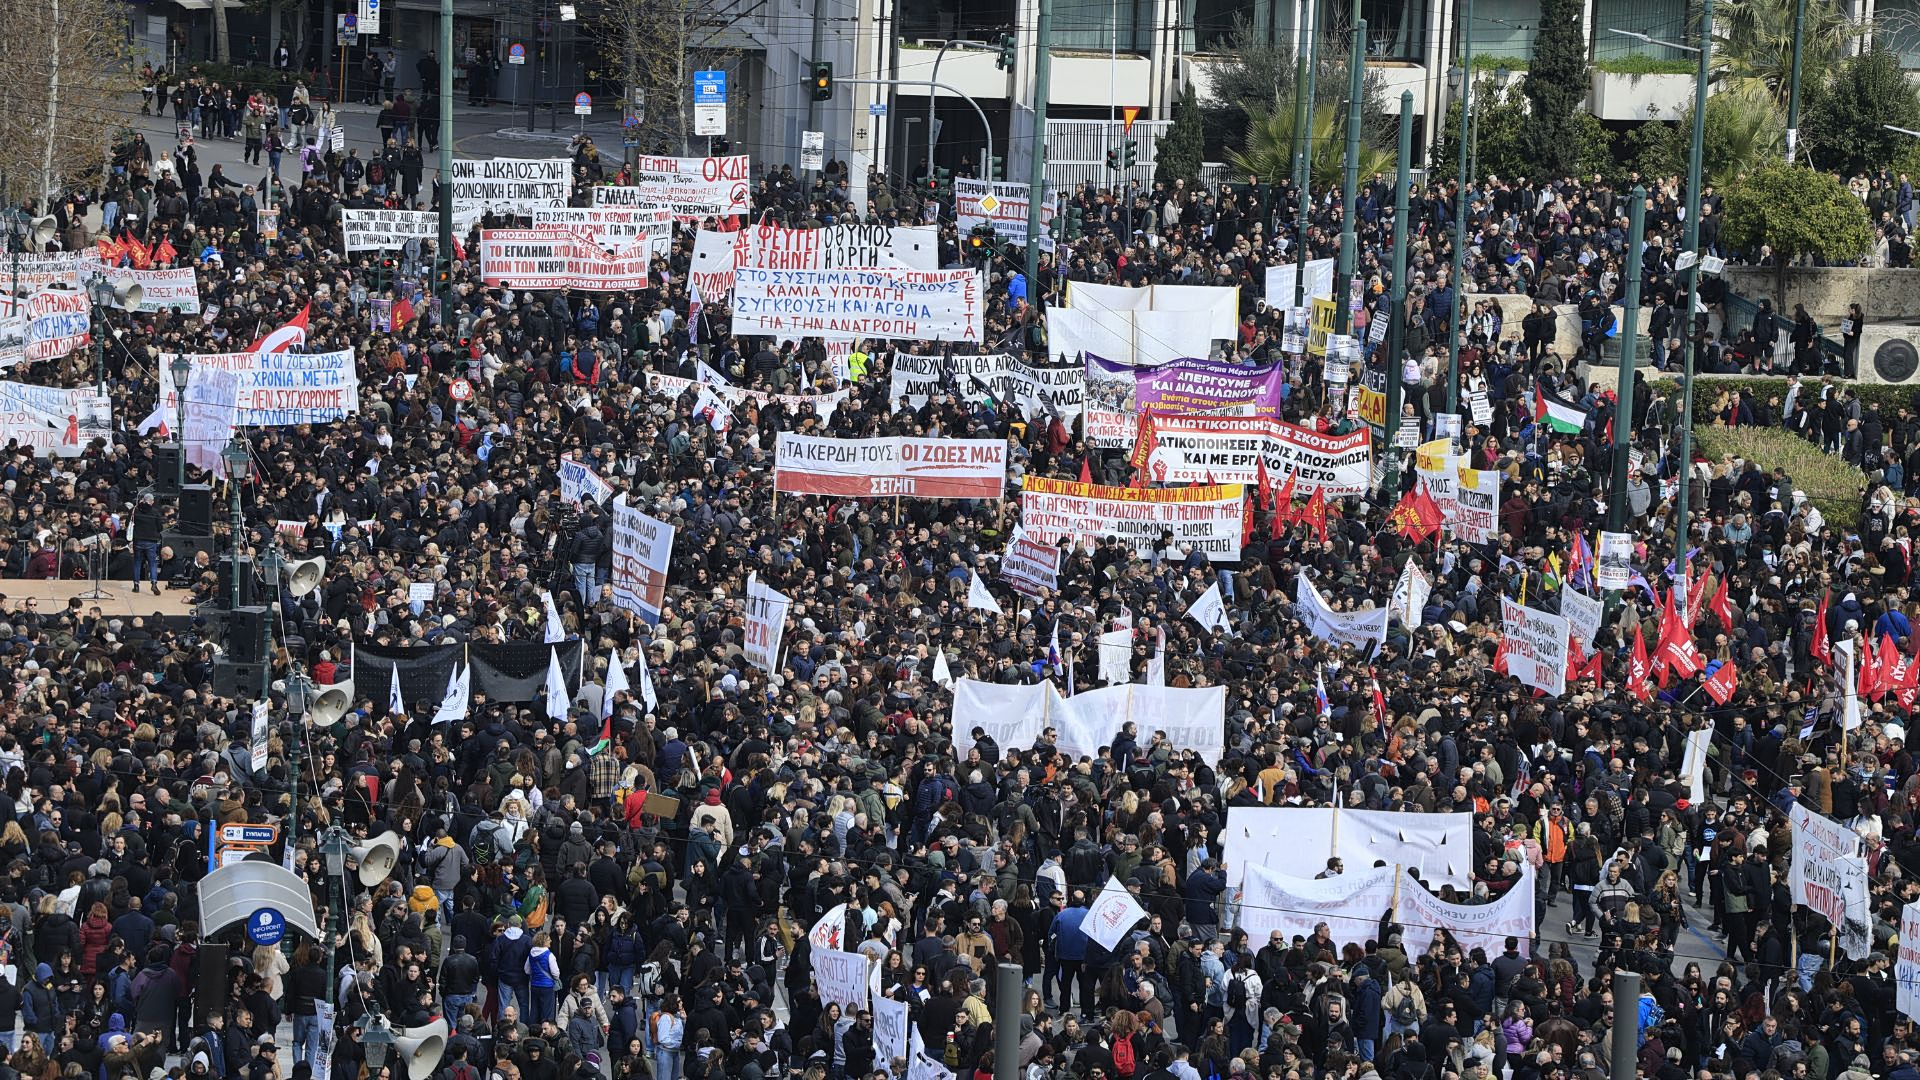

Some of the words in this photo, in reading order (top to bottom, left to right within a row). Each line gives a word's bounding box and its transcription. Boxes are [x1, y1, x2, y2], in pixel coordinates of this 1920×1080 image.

[452, 162, 474, 178] ΟΝΗ
[484, 162, 563, 179] ΔΙΚΑΙΟΣΥΝΗ
[702, 156, 748, 182] ΟΚΔΕ
[452, 182, 504, 200] ΚΟΙΝΩΝΙΚΗ
[508, 181, 564, 199] ΕΠΑΝΑΣΤΑΣΗ
[993, 186, 1004, 196] ΤΑ
[536, 212, 550, 222] ΣΤΟ
[552, 210, 584, 222] ΣΥΣΤΗΜΑ
[588, 211, 601, 222] ΤΟΥ
[604, 211, 632, 222] ΚΕΡΔΟΥΣ
[671, 204, 720, 214] ΚΥΒΕΡΝΗΣΗ
[492, 232, 556, 240] ΟΜΟΣΠΟΝΔΙΑ
[609, 225, 621, 236] ΓΙΑ
[624, 225, 637, 236] ΤΗΝ
[758, 227, 819, 251] ΦΕΥΓΕΙ
[836, 226, 893, 248] ΘΥΜΟΣ
[490, 246, 502, 258] ΤΟ
[505, 246, 552, 258] ΕΓΚΛΗΜΑ
[554, 246, 570, 258] ΑΥΤΟ
[758, 250, 819, 270] ΣΒΗΝΕΙ
[826, 250, 832, 268] Η
[838, 246, 878, 268] ΟΡΓΗ
[134, 268, 193, 280] ΣΥΓΧΩΡΟΥΜΕ
[485, 260, 512, 272] ΟΛΩΝ
[514, 260, 536, 272] ΤΩΝ
[568, 261, 580, 274] ΘΑ
[583, 262, 626, 274] ΓΙΝΟΥΜΕ
[605, 279, 640, 288] ΑΘΗΝΑΣ
[737, 269, 766, 282] ΣΤΟ
[774, 271, 850, 285] ΣΥΣΤΗΜΑ
[858, 273, 882, 286] ΤΟΥ
[890, 279, 958, 294] ΚΕΡΔΟΥΣ
[146, 287, 172, 298] ΖΩΕΣ
[176, 286, 198, 296] ΜΑΣ
[766, 284, 820, 298] ΚΑΜΙΑ
[832, 286, 904, 301] ΥΠΟΤΑΓΗ
[737, 298, 836, 313] ΣΥΓΚΡΟΥΣΗ
[844, 300, 867, 313] ΚΑΙ
[875, 302, 931, 318] ΑΓΩΝΑ
[760, 316, 783, 328] ΓΙΑ
[791, 316, 824, 330] ΤΗΝ
[830, 319, 916, 335] ΑΝΑΤΡΟΠΗ
[232, 354, 254, 370] ΤΟΥΣ
[262, 354, 269, 369] Η
[274, 354, 283, 370] ΟΙ
[321, 354, 344, 369] ΜΑΣ
[896, 356, 944, 374] ΔΙΚΑΙΟΣΥΝ
[952, 357, 972, 374] ΔΕΝ
[974, 356, 990, 374] ΘΑ
[1042, 372, 1050, 384] ΟΙ
[252, 372, 294, 387] ΧΡΟΝΙΑ
[303, 370, 338, 386] ΜΕΤΑ
[1152, 380, 1172, 390] ΚΑΙ
[1178, 372, 1251, 388] ΑΠΕΡΓΟΥΜΕ
[1052, 388, 1080, 406] ΛΑΟΣ
[1192, 398, 1217, 406] στους
[249, 409, 304, 425] ΣΥΛΛΟΓΟΙ
[1167, 418, 1292, 438] ΙΔΙΩΤΙΚΟΠΟΙΗΣΕΙΣ
[1294, 430, 1363, 450] ΣΚΟΤΩΝΟΥΝ
[1095, 438, 1123, 448] ΟΙΝΟΣ
[786, 442, 803, 458] ΤΑ
[807, 443, 856, 462] ΚΕΡΔΗ
[861, 444, 893, 462] ΤΟΥΣ
[902, 444, 918, 460] ΟΙ
[922, 446, 967, 464] ΖΩΕΣ
[972, 446, 1001, 464] ΜΑΣ
[1184, 452, 1208, 464] ΚΑΙ
[1210, 454, 1228, 465] ΜΕ
[870, 476, 916, 494] ΣΕΤΗΠ
[1026, 476, 1084, 495] ΑΓΩΝΙΣΤΙΚΕΣ
[1088, 482, 1124, 499] ΚΙΝΗΣΕΙΣ
[1429, 478, 1450, 493] ΧΙΟΣ
[1024, 494, 1040, 510] ΜΕ
[1046, 496, 1088, 516] ΑΓΩΝΕΣ
[1096, 502, 1156, 520] ΚΕΡΔΙΖΟΥΜΕ
[1162, 506, 1172, 520] ΤΟ
[1220, 502, 1239, 519] ΜΑΣ
